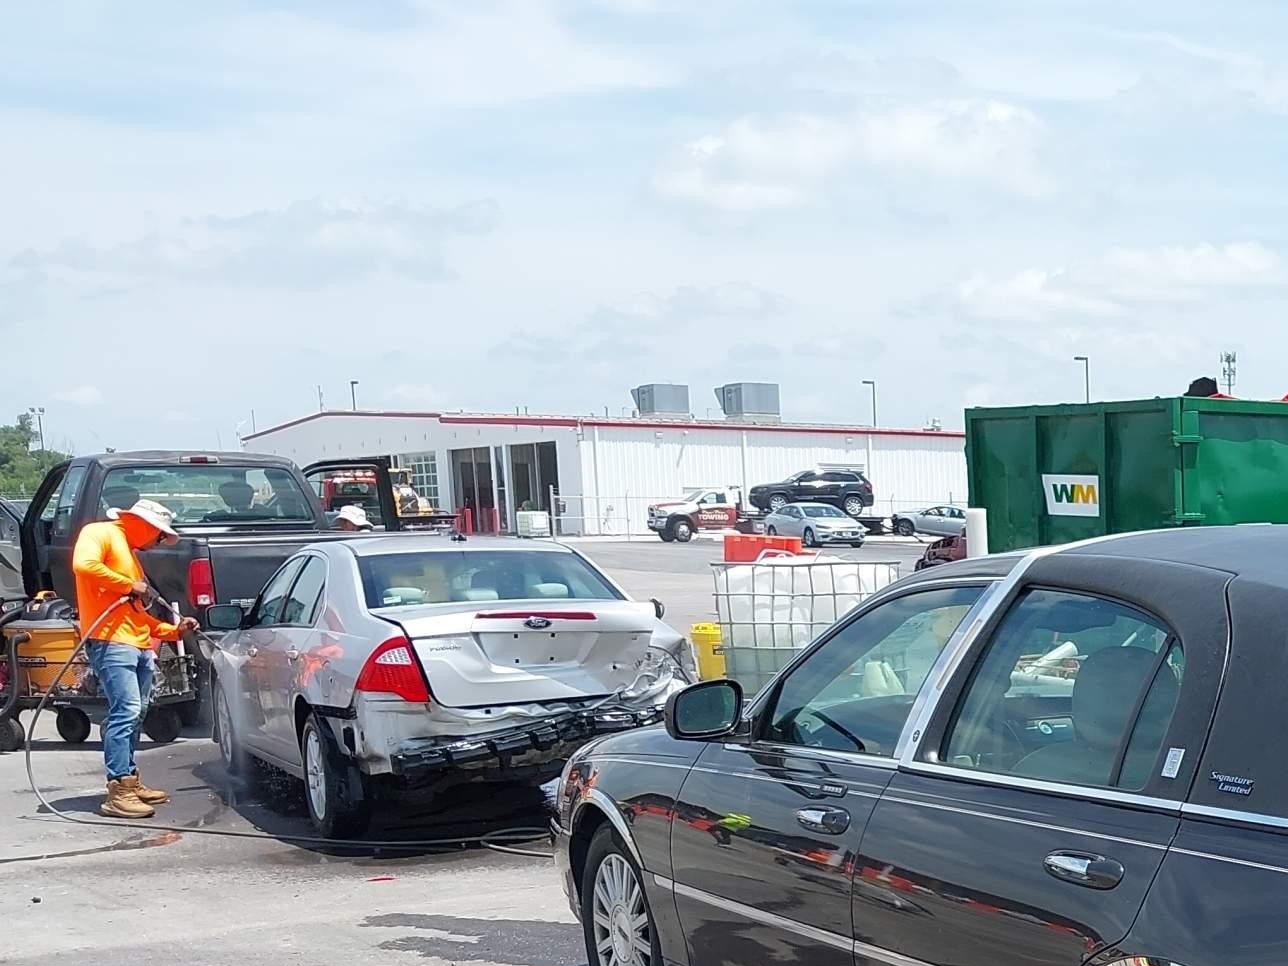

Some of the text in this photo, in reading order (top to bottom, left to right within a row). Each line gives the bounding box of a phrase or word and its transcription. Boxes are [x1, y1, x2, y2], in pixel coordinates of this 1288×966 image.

[1052, 484, 1097, 504] WM
[1211, 771, 1254, 786] Signature
[1218, 782, 1251, 795] Limited
